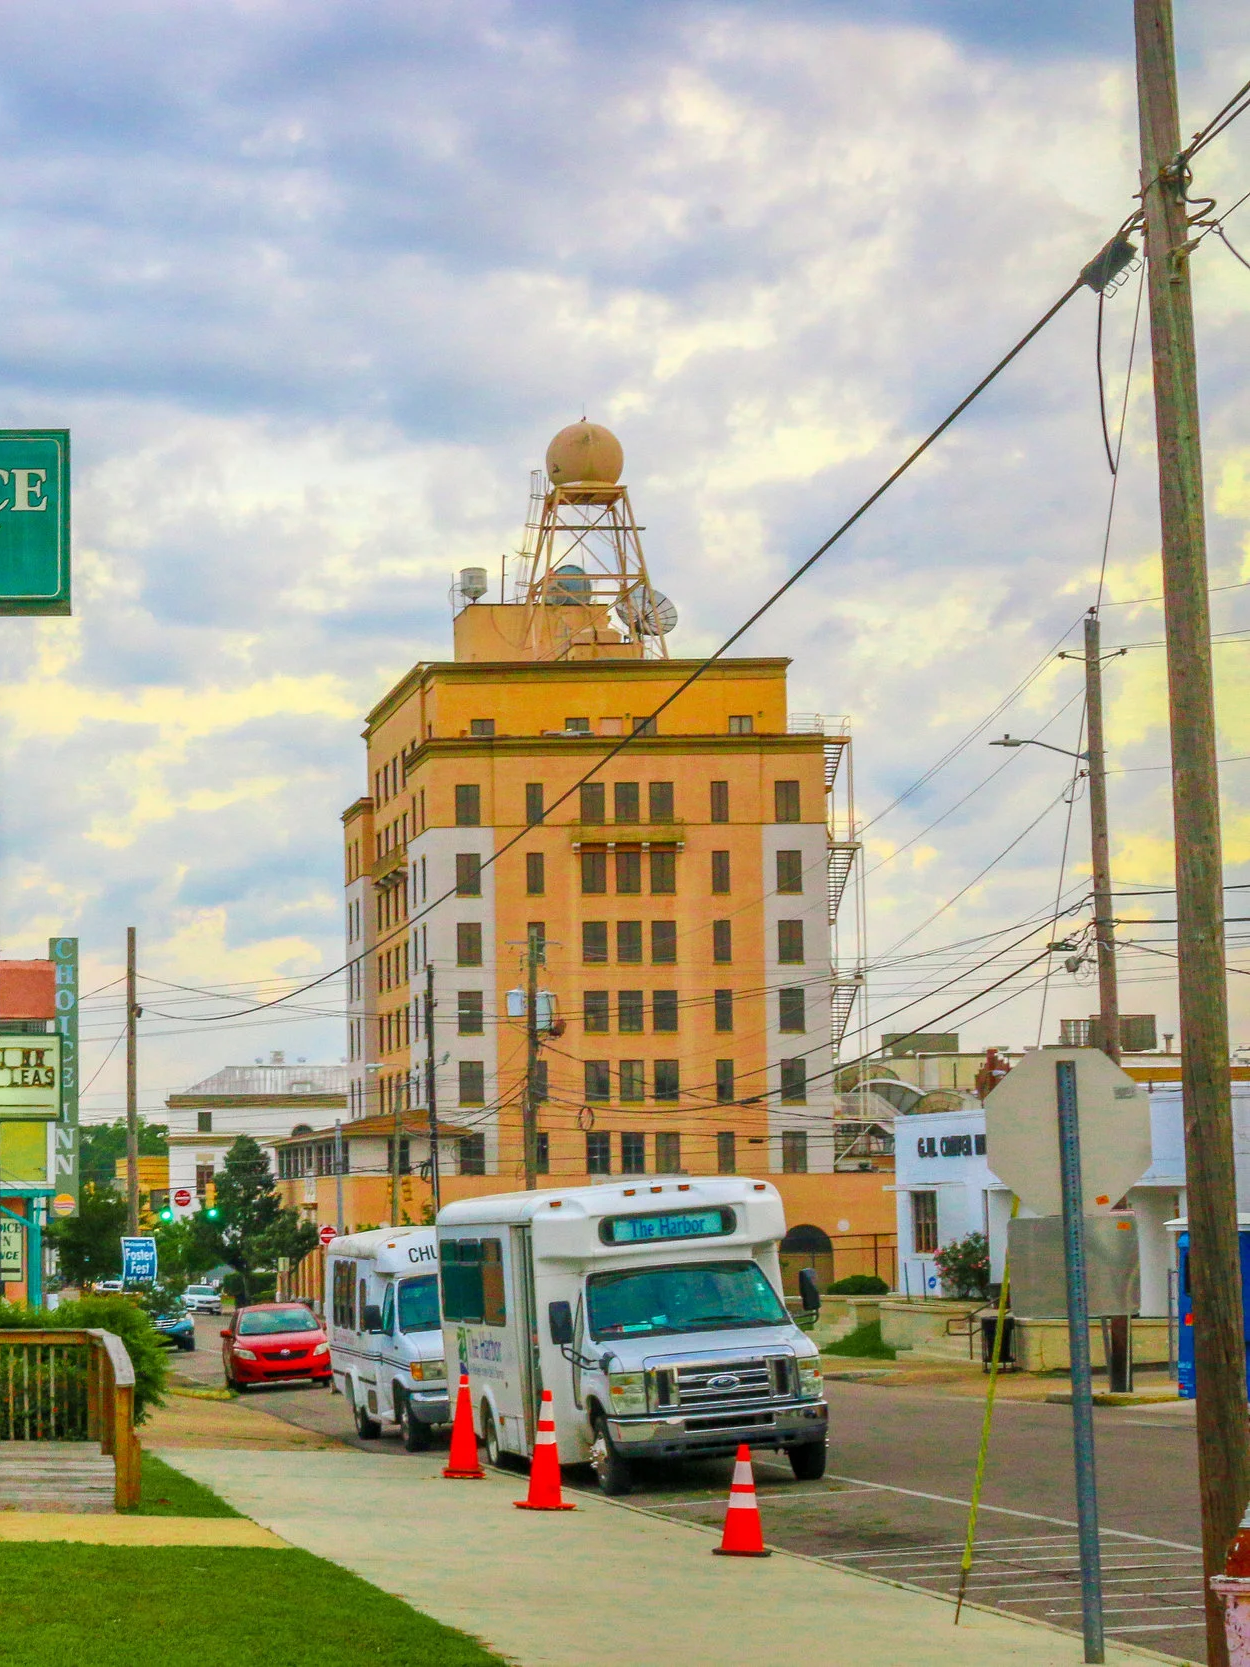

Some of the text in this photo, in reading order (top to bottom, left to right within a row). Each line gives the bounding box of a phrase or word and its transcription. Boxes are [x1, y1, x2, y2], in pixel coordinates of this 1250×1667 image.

[629, 1215, 706, 1238] The Harbor
[125, 1247, 154, 1261] Foster
[131, 1261, 150, 1275] Fest
